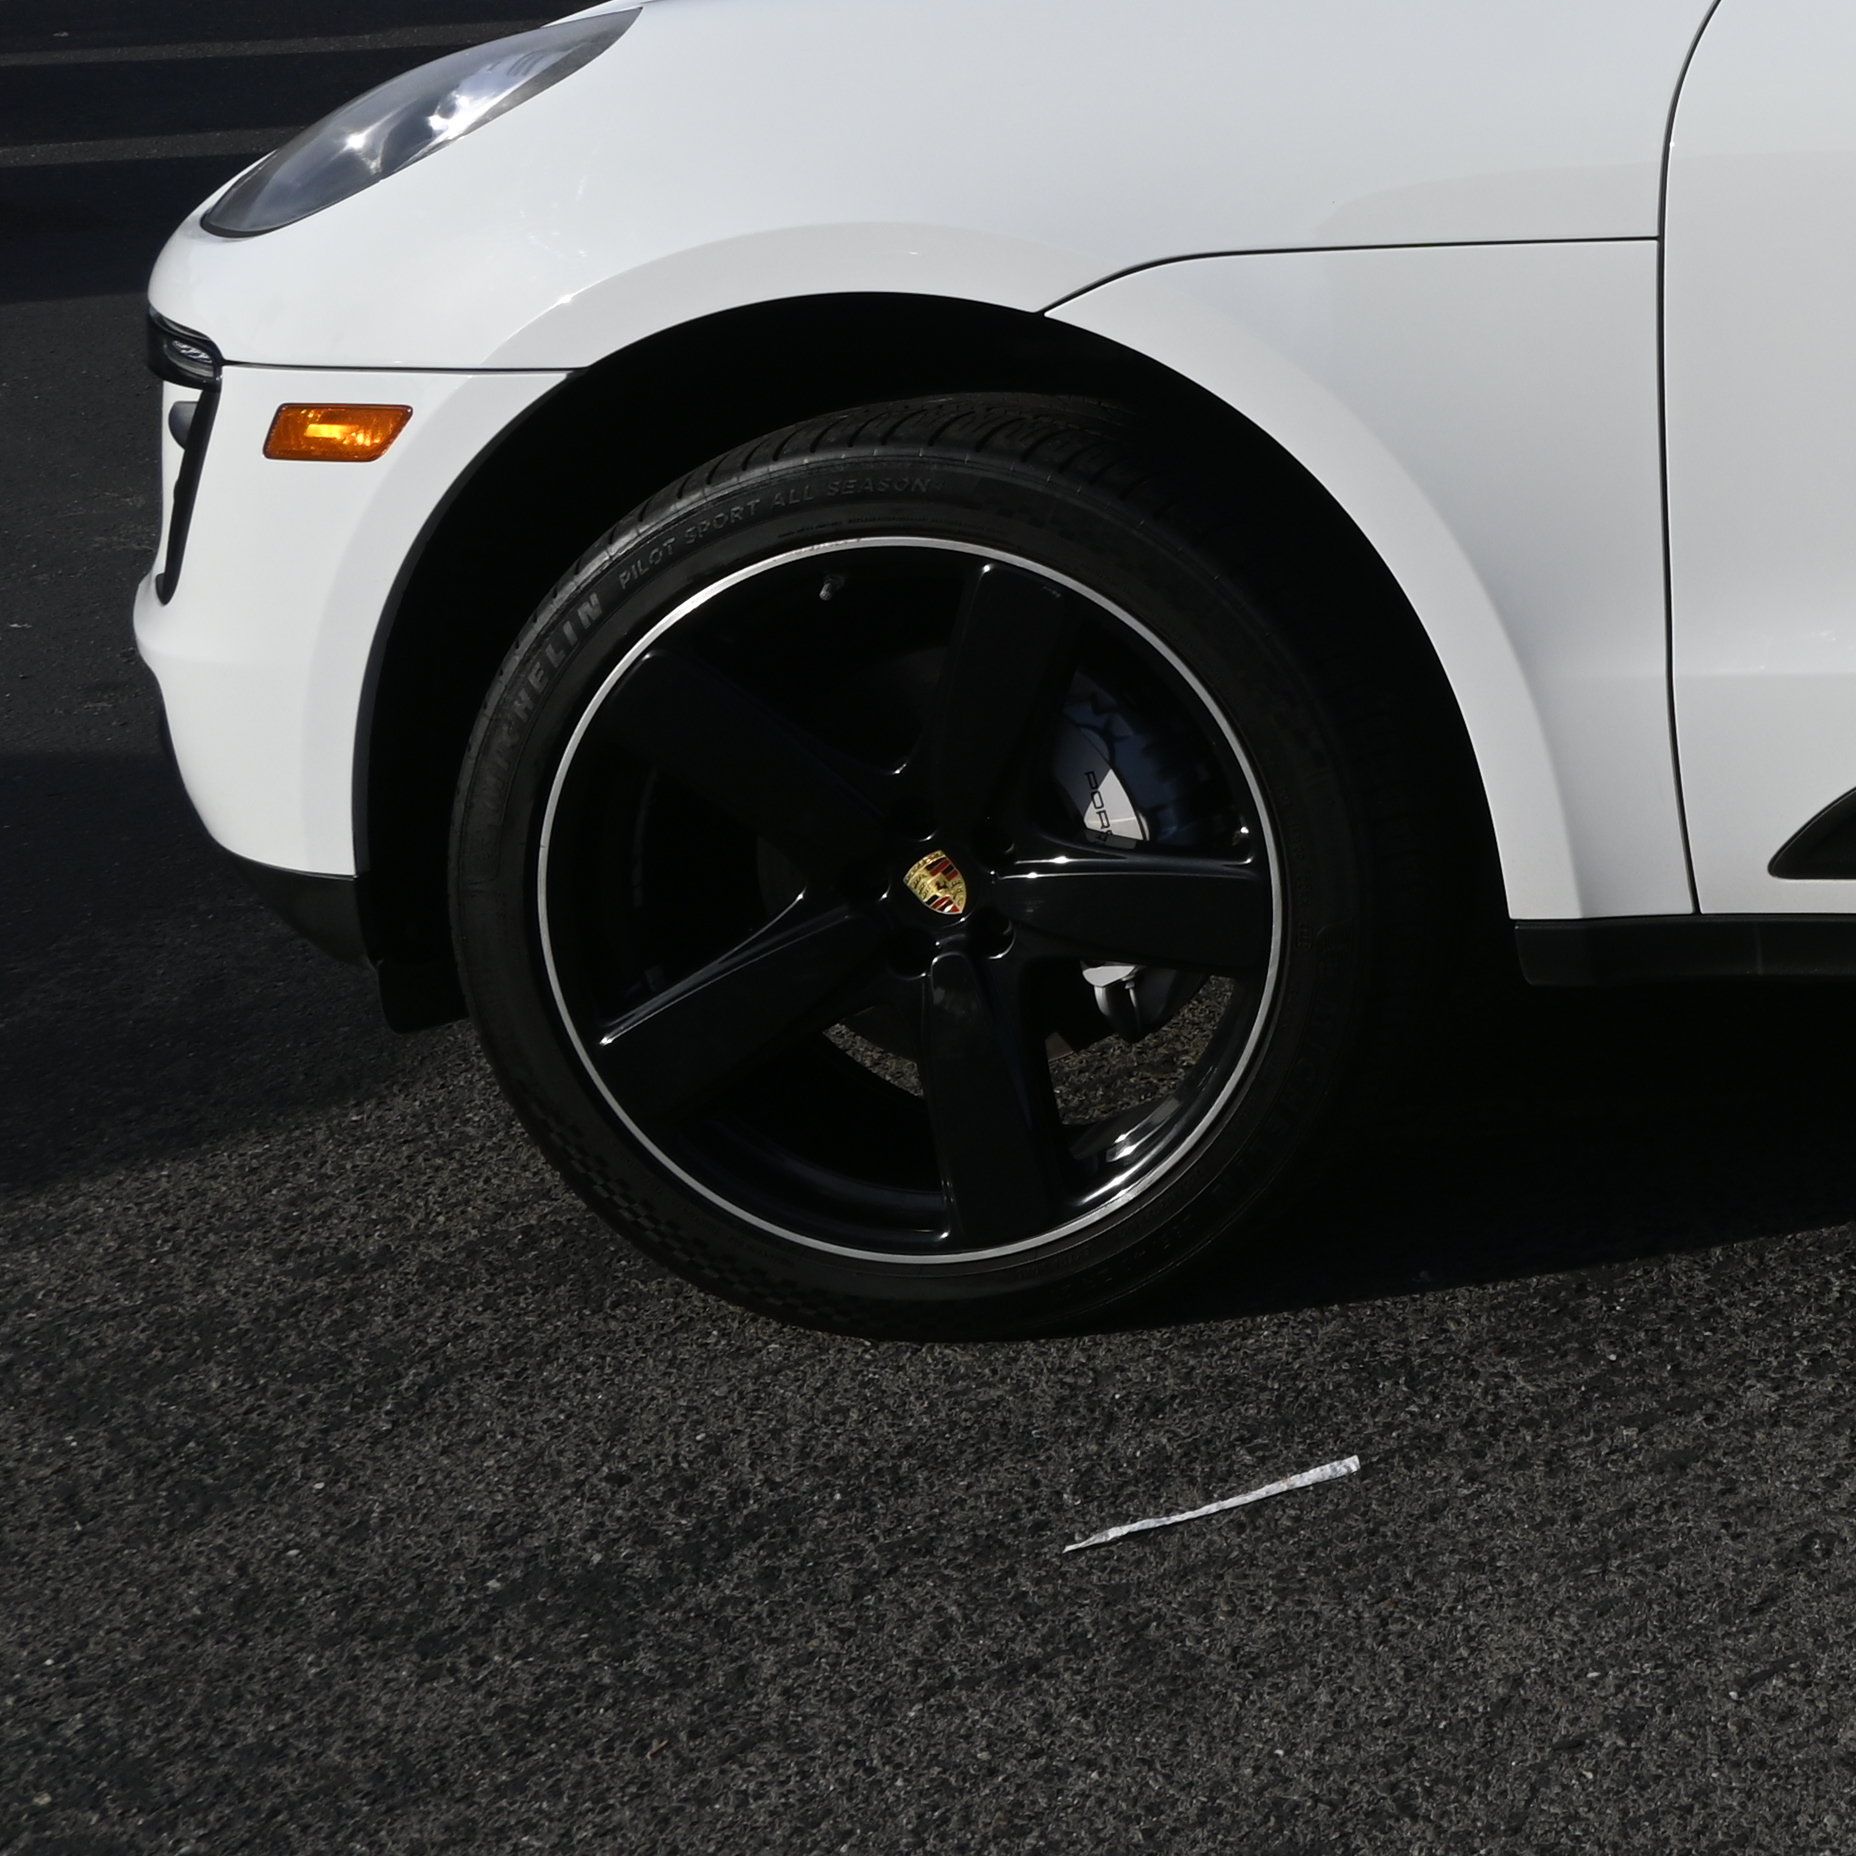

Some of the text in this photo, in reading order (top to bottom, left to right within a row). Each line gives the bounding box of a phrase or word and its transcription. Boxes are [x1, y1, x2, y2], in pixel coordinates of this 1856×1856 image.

[473, 592, 604, 811] MICHELIN
[616, 536, 677, 589] PILOT
[683, 499, 762, 544] SPORT
[771, 485, 815, 510] ALL
[827, 477, 931, 496] SEASON
